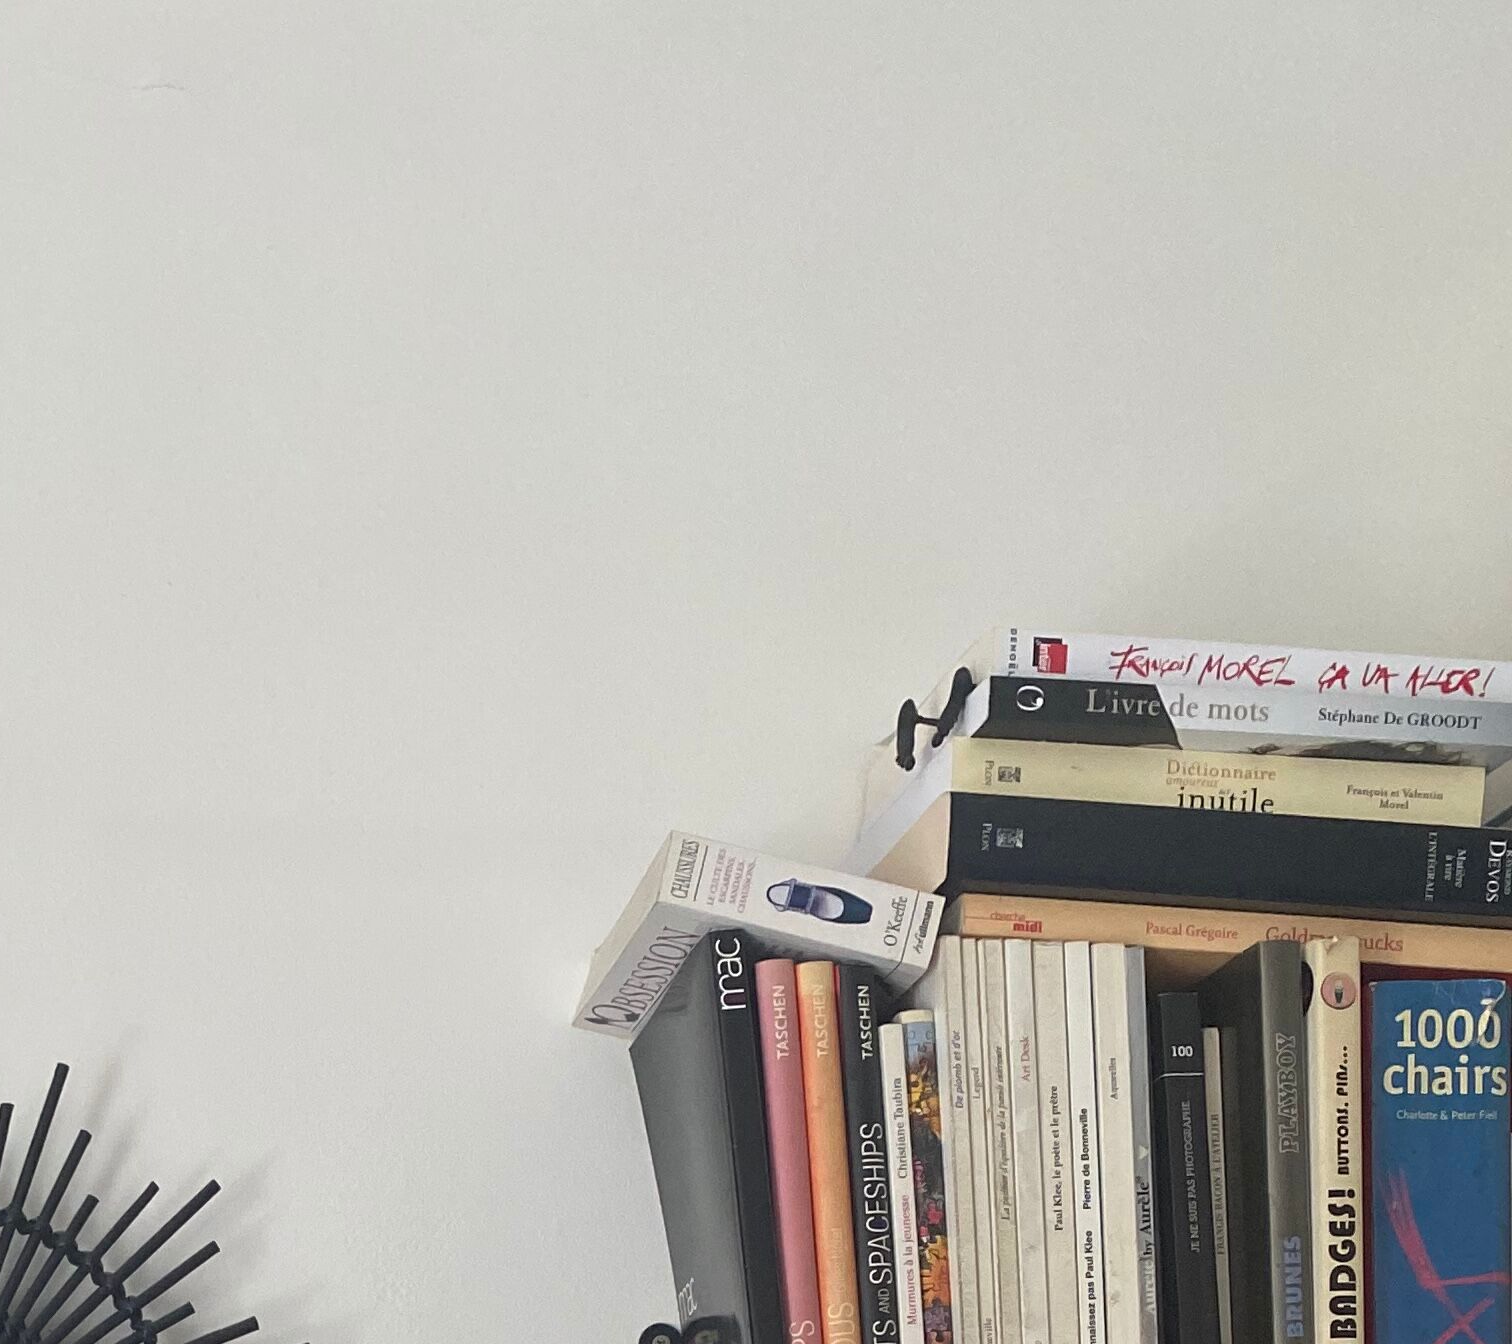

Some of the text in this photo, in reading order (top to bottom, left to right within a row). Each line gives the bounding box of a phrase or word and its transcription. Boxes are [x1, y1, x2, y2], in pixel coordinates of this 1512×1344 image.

[1197, 655, 1295, 687] MOREL
[1361, 667, 1399, 693] VA
[1406, 668, 1495, 698] ALLER!
[1169, 693, 1199, 718] de
[1208, 702, 1270, 721] mots
[1318, 708, 1483, 730] Stéphane De GROODT
[1167, 760, 1276, 781] Dictionnaire
[1177, 787, 1274, 813] inutile
[671, 840, 699, 899] CHAUSSURES
[1486, 841, 1507, 902] DEVOS
[883, 896, 909, 946] O'Keeffe
[1013, 920, 1042, 933] midi
[1145, 921, 1239, 943] Pascal Grégoire
[584, 926, 701, 1030] OBSESSION
[716, 938, 746, 1009] mac
[771, 985, 789, 1062] TASCHEN
[812, 985, 829, 1060] TASCHEN
[857, 985, 874, 1062] TASCHEN
[1394, 1006, 1502, 1049] 1000
[1276, 1033, 1301, 1155] PLAYBOY
[1382, 1054, 1508, 1098] chairs
[891, 1078, 909, 1182] Christiane Taubira
[1078, 1109, 1090, 1162] Bonneville
[1080, 1163, 1090, 1176] de
[860, 1124, 894, 1286] SPACESHIPS
[1082, 1178, 1092, 1211] Pierre
[1083, 1231, 1094, 1255] Klee
[1327, 1188, 1357, 1340] BADGES!
[1085, 1257, 1095, 1280] Paul
[1284, 1236, 1305, 1339] BRUNES
[877, 1290, 891, 1316] AND
[1088, 1282, 1099, 1305] pas
